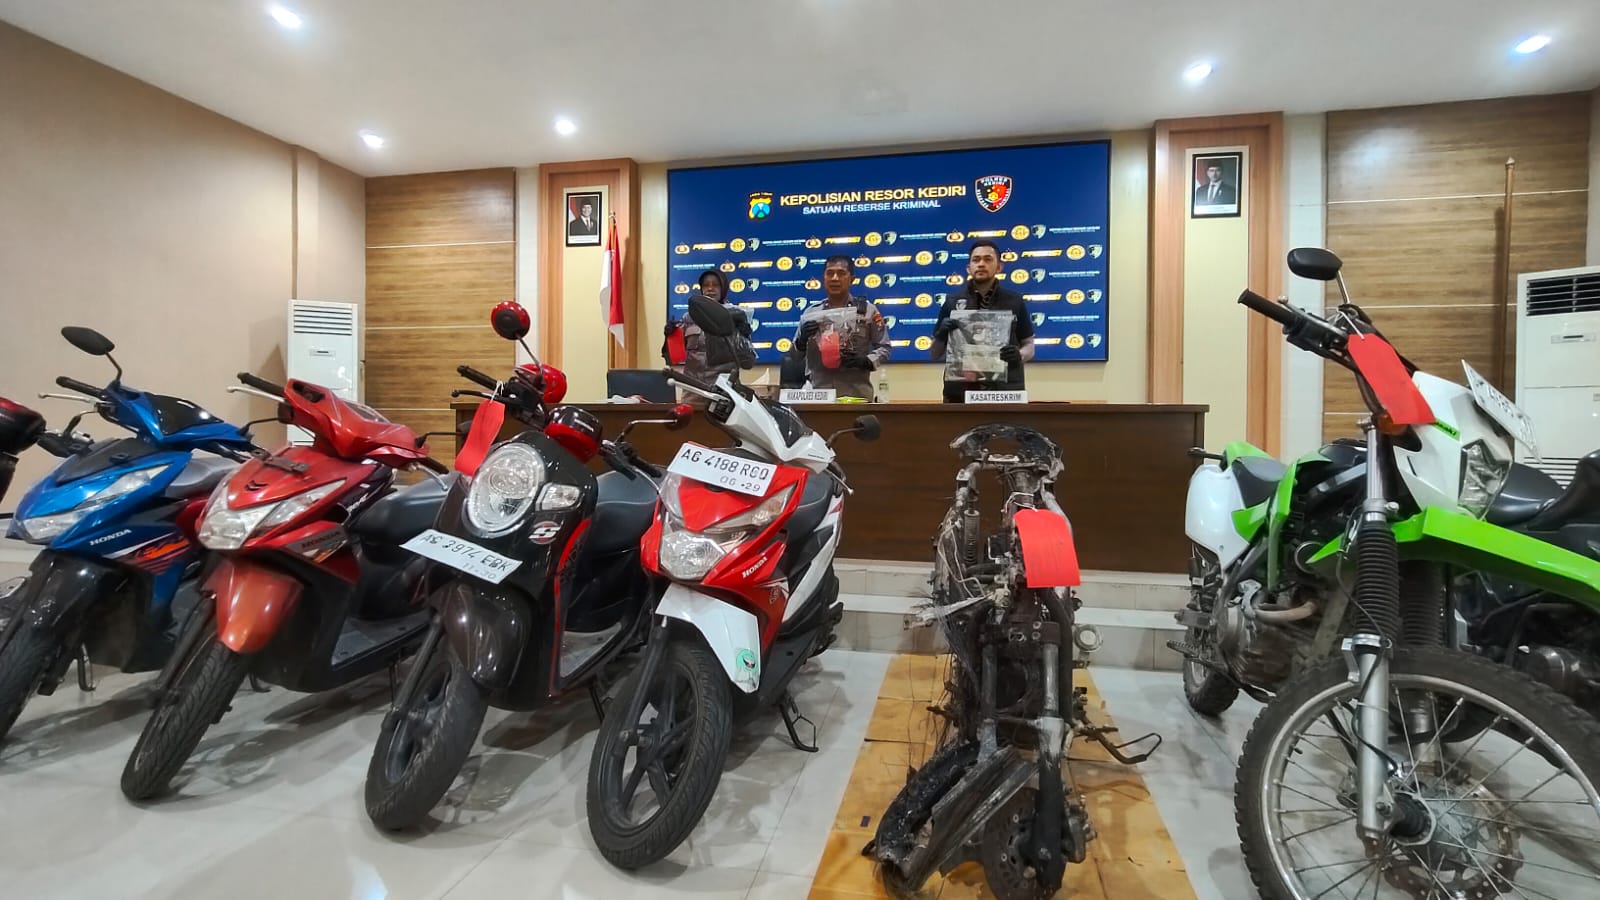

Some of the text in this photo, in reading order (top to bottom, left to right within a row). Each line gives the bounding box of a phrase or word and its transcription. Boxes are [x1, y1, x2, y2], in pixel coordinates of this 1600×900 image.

[780, 192, 861, 207] KEPOLISIAN
[864, 189, 915, 203] RESOR
[917, 185, 966, 199] KEDIRI
[802, 199, 941, 215] SATUAN RESERSE KRIMINAL
[970, 393, 1022, 402] KASATRESKRIM
[681, 448, 703, 463] AG
[704, 454, 739, 473] 4188
[89, 528, 133, 547] HONDA
[442, 539, 483, 559] 3974
[480, 554, 513, 572] EBK
[742, 556, 769, 579] HONDA
